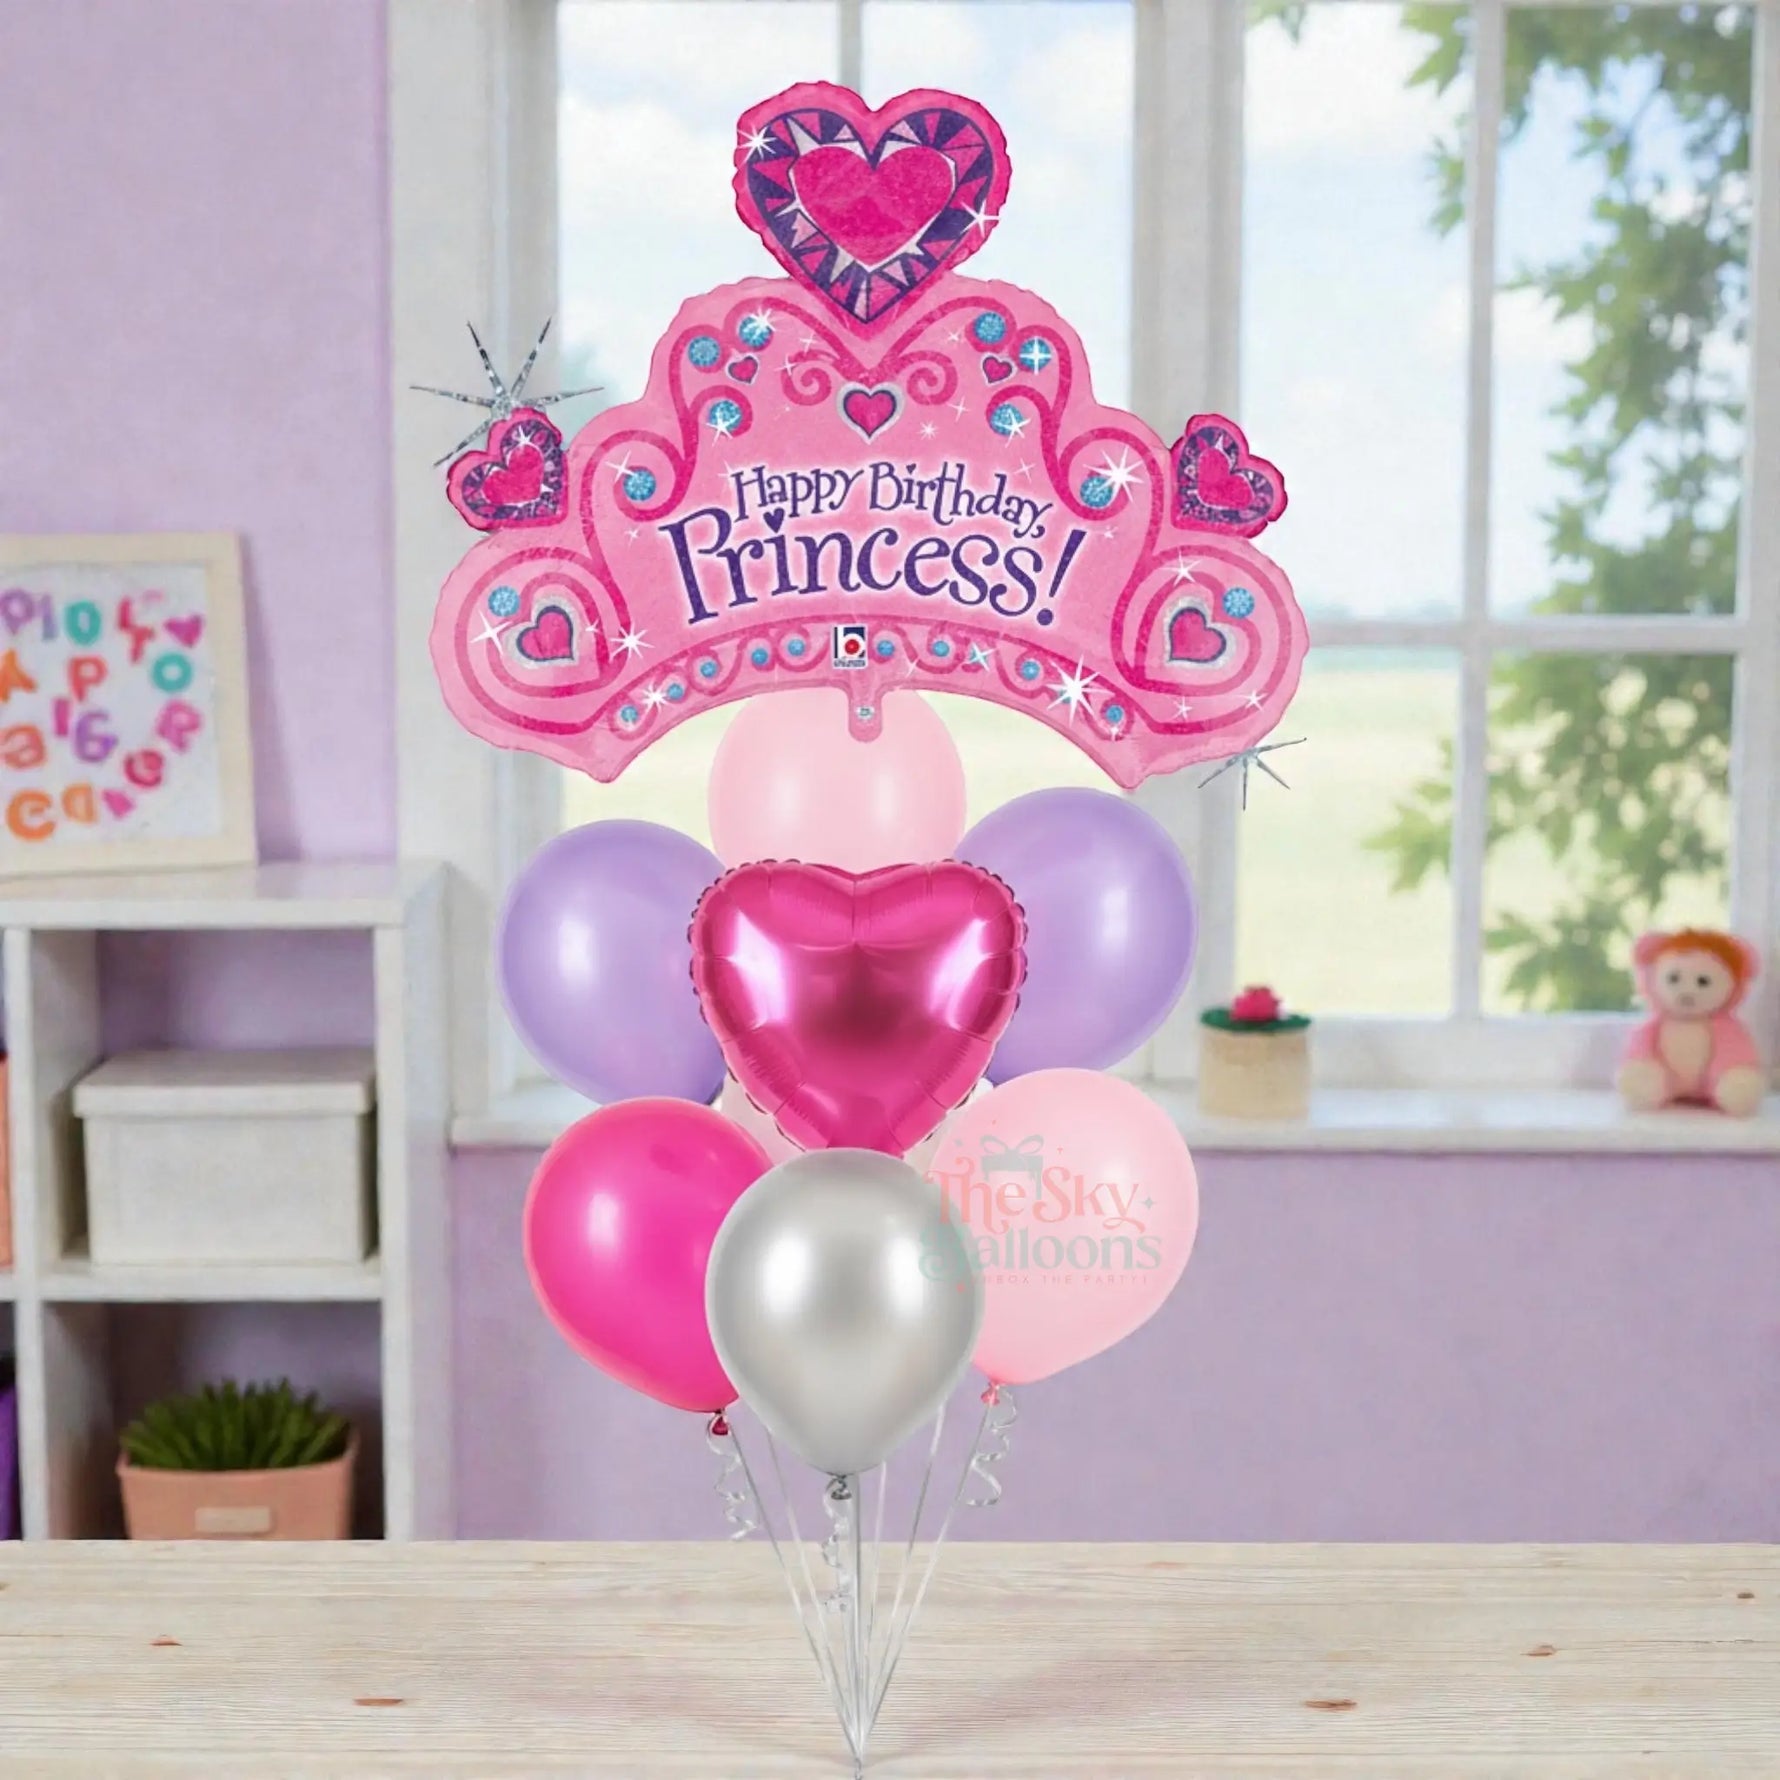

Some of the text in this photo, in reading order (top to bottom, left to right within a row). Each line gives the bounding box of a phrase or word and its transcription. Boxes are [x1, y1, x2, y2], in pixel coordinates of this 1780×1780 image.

[731, 461, 1053, 539] Happy Birthday,
[658, 507, 1087, 626] Princess!
